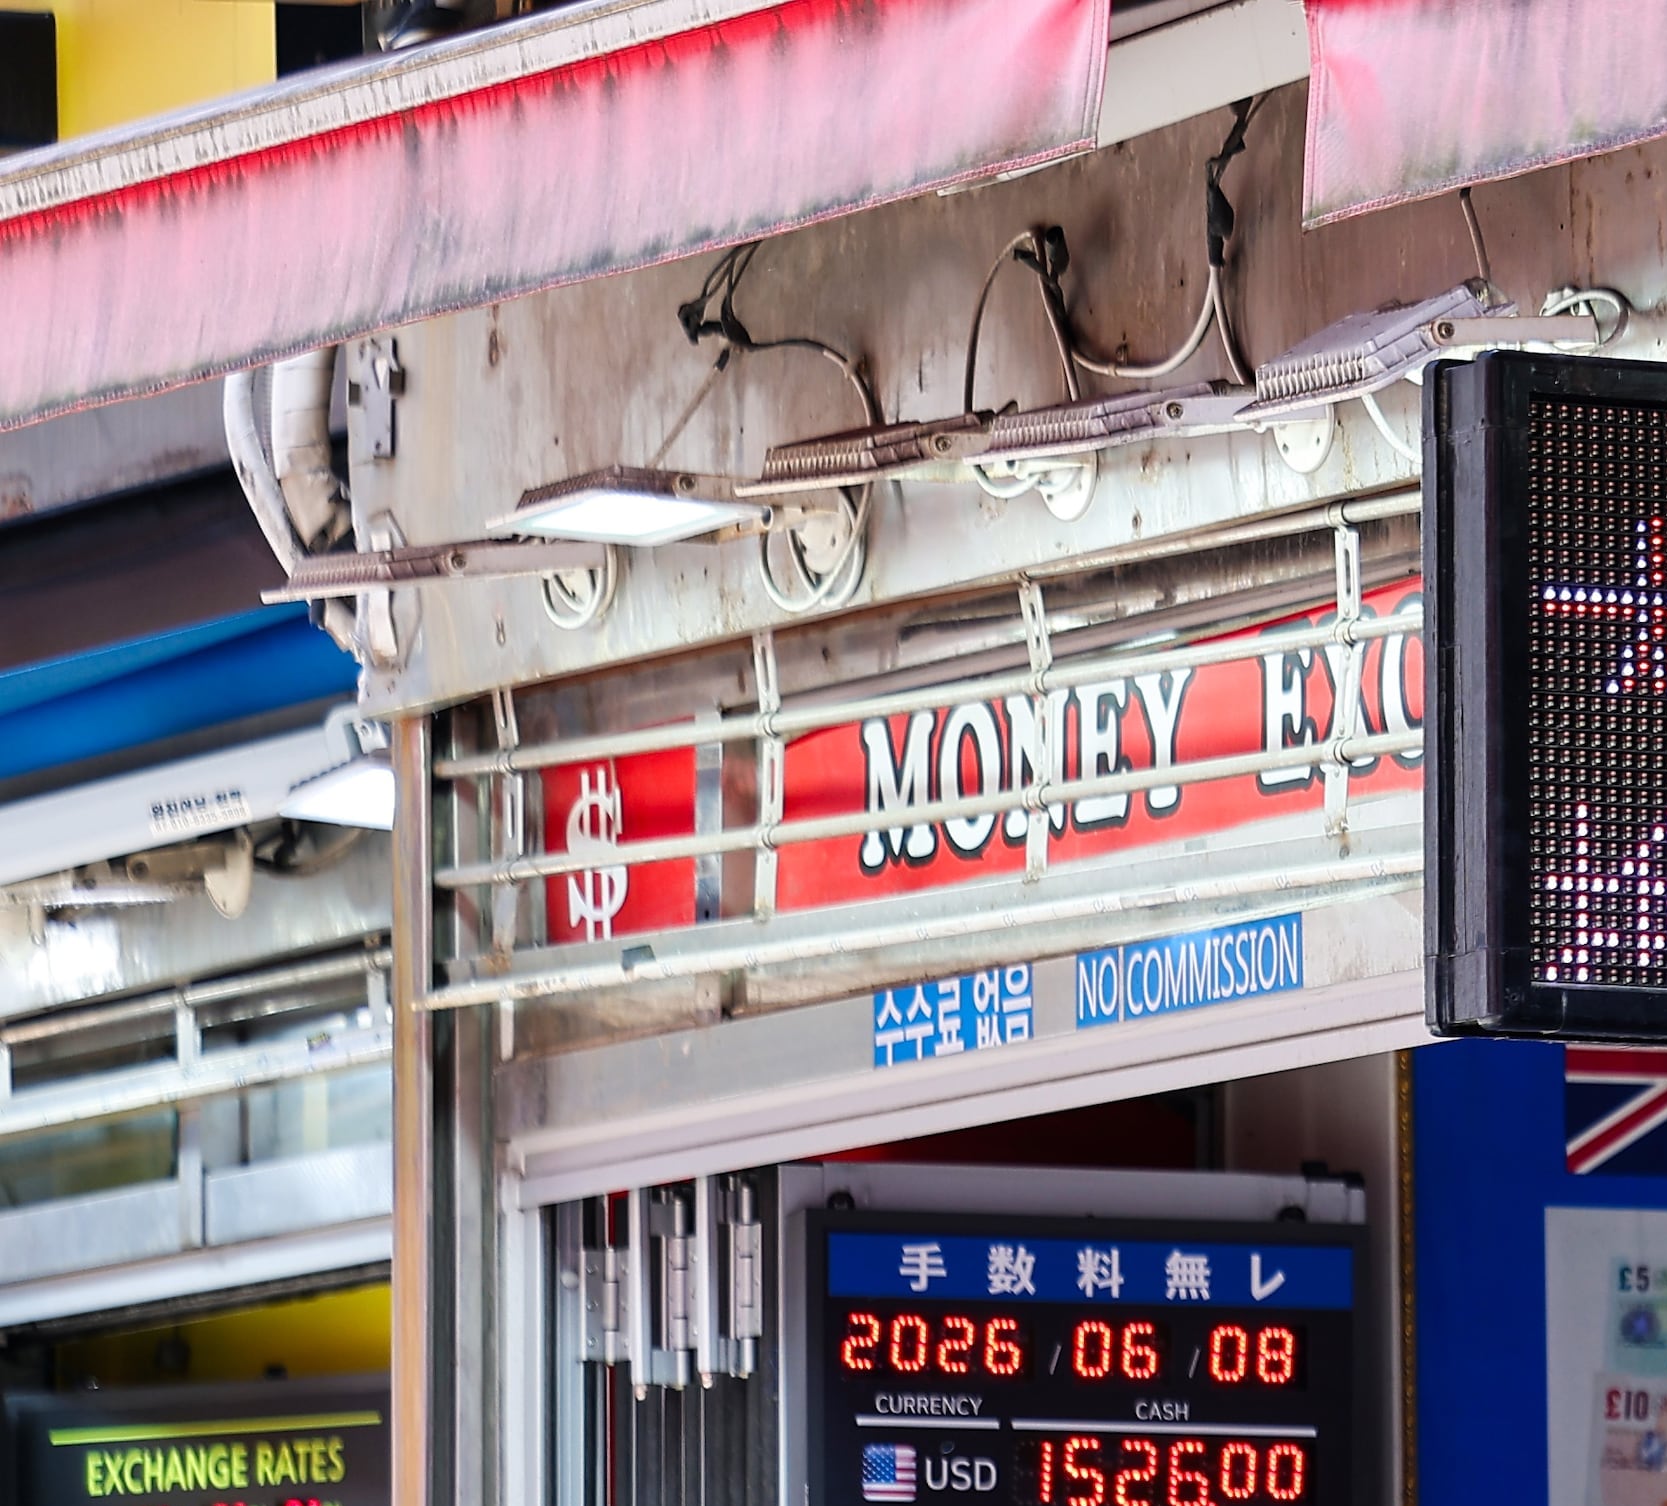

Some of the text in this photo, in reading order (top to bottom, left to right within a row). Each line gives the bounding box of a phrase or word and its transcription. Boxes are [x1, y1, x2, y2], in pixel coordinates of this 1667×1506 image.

[862, 665, 1191, 872] MONEY
[875, 978, 965, 1068] 수수료
[1078, 955, 1117, 1020] NO
[1128, 922, 1299, 1016] COMMISSION
[841, 1313, 1295, 1385] 2026 06 08
[875, 1394, 1190, 1423] CURRENCY CASH
[1604, 1389, 1650, 1422] £10
[86, 1435, 346, 1497] EXCHANGE RATES
[925, 1457, 997, 1493] USD
